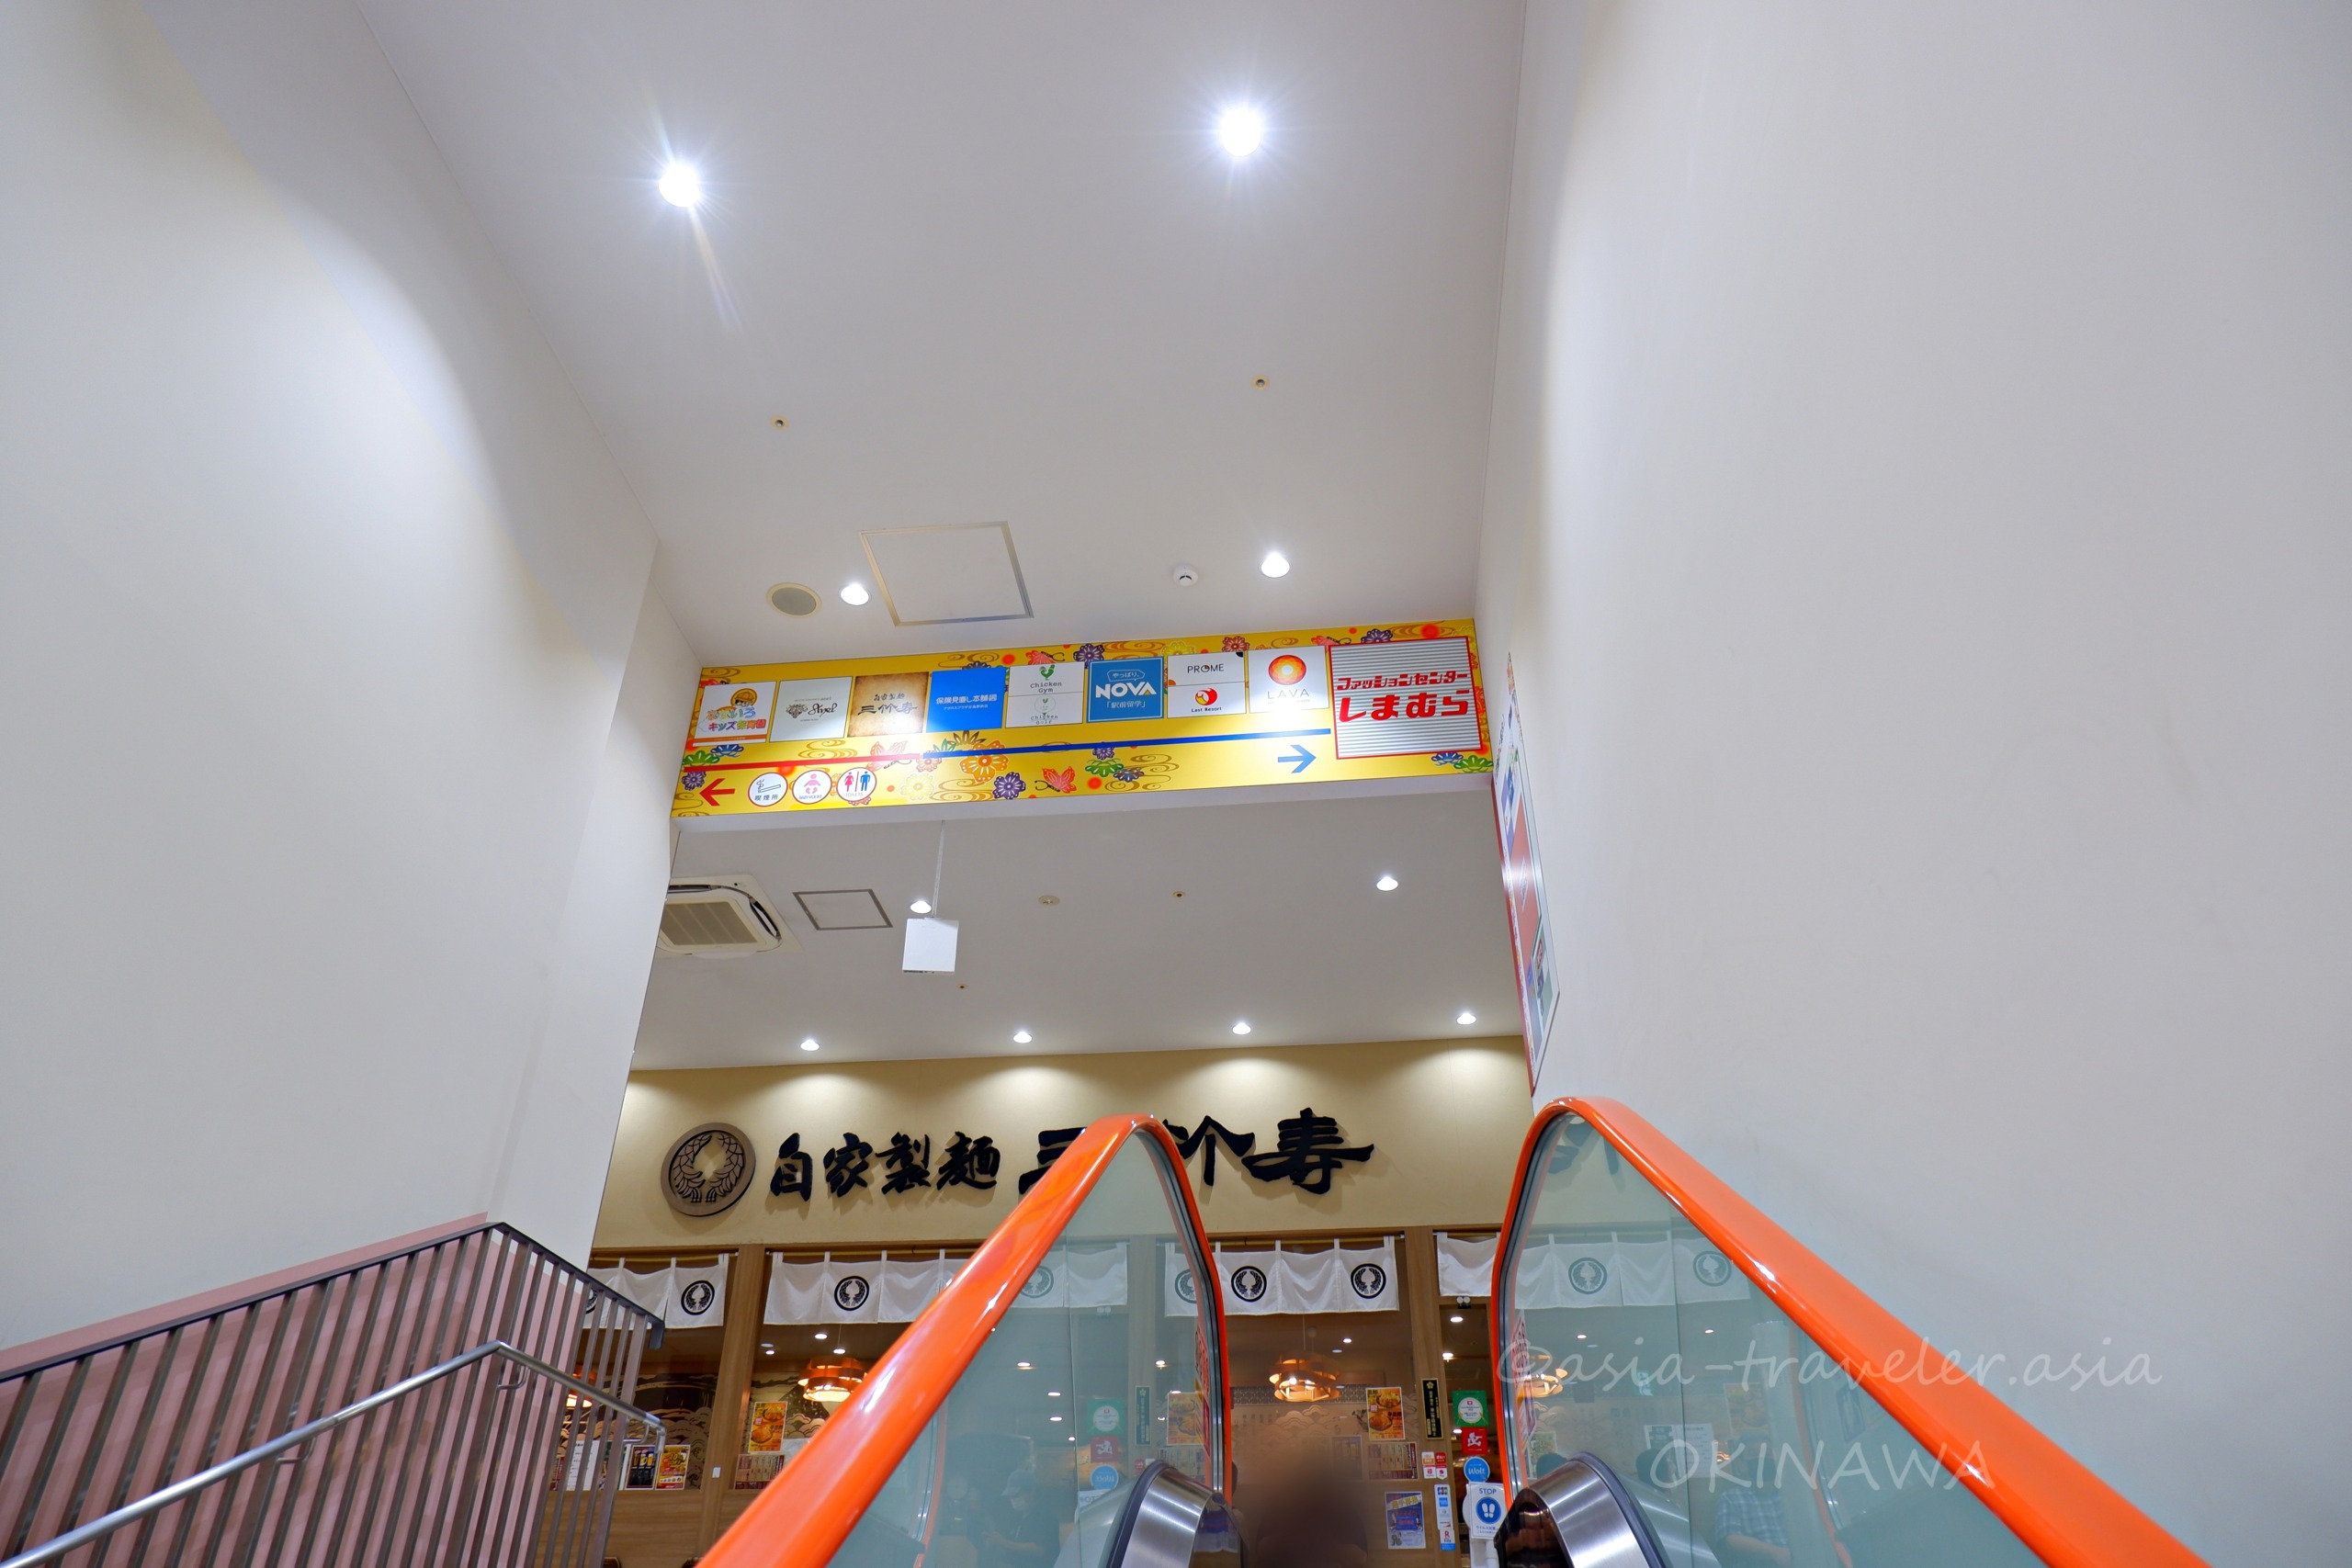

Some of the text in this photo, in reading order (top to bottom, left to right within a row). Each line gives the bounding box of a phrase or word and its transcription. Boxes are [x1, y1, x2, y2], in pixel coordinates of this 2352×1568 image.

[1187, 663, 1225, 674] PROME
[1030, 681, 1062, 689] Chicken
[1337, 670, 1468, 691] ファッションセンター
[1095, 681, 1158, 700] NOVA
[1267, 688, 1310, 699] LAVA
[1339, 689, 1470, 723] しまむら
[708, 718, 767, 732] キッズ保育園
[754, 794, 779, 802] 喫煙所
[770, 1131, 1001, 1201] 自家製麺
